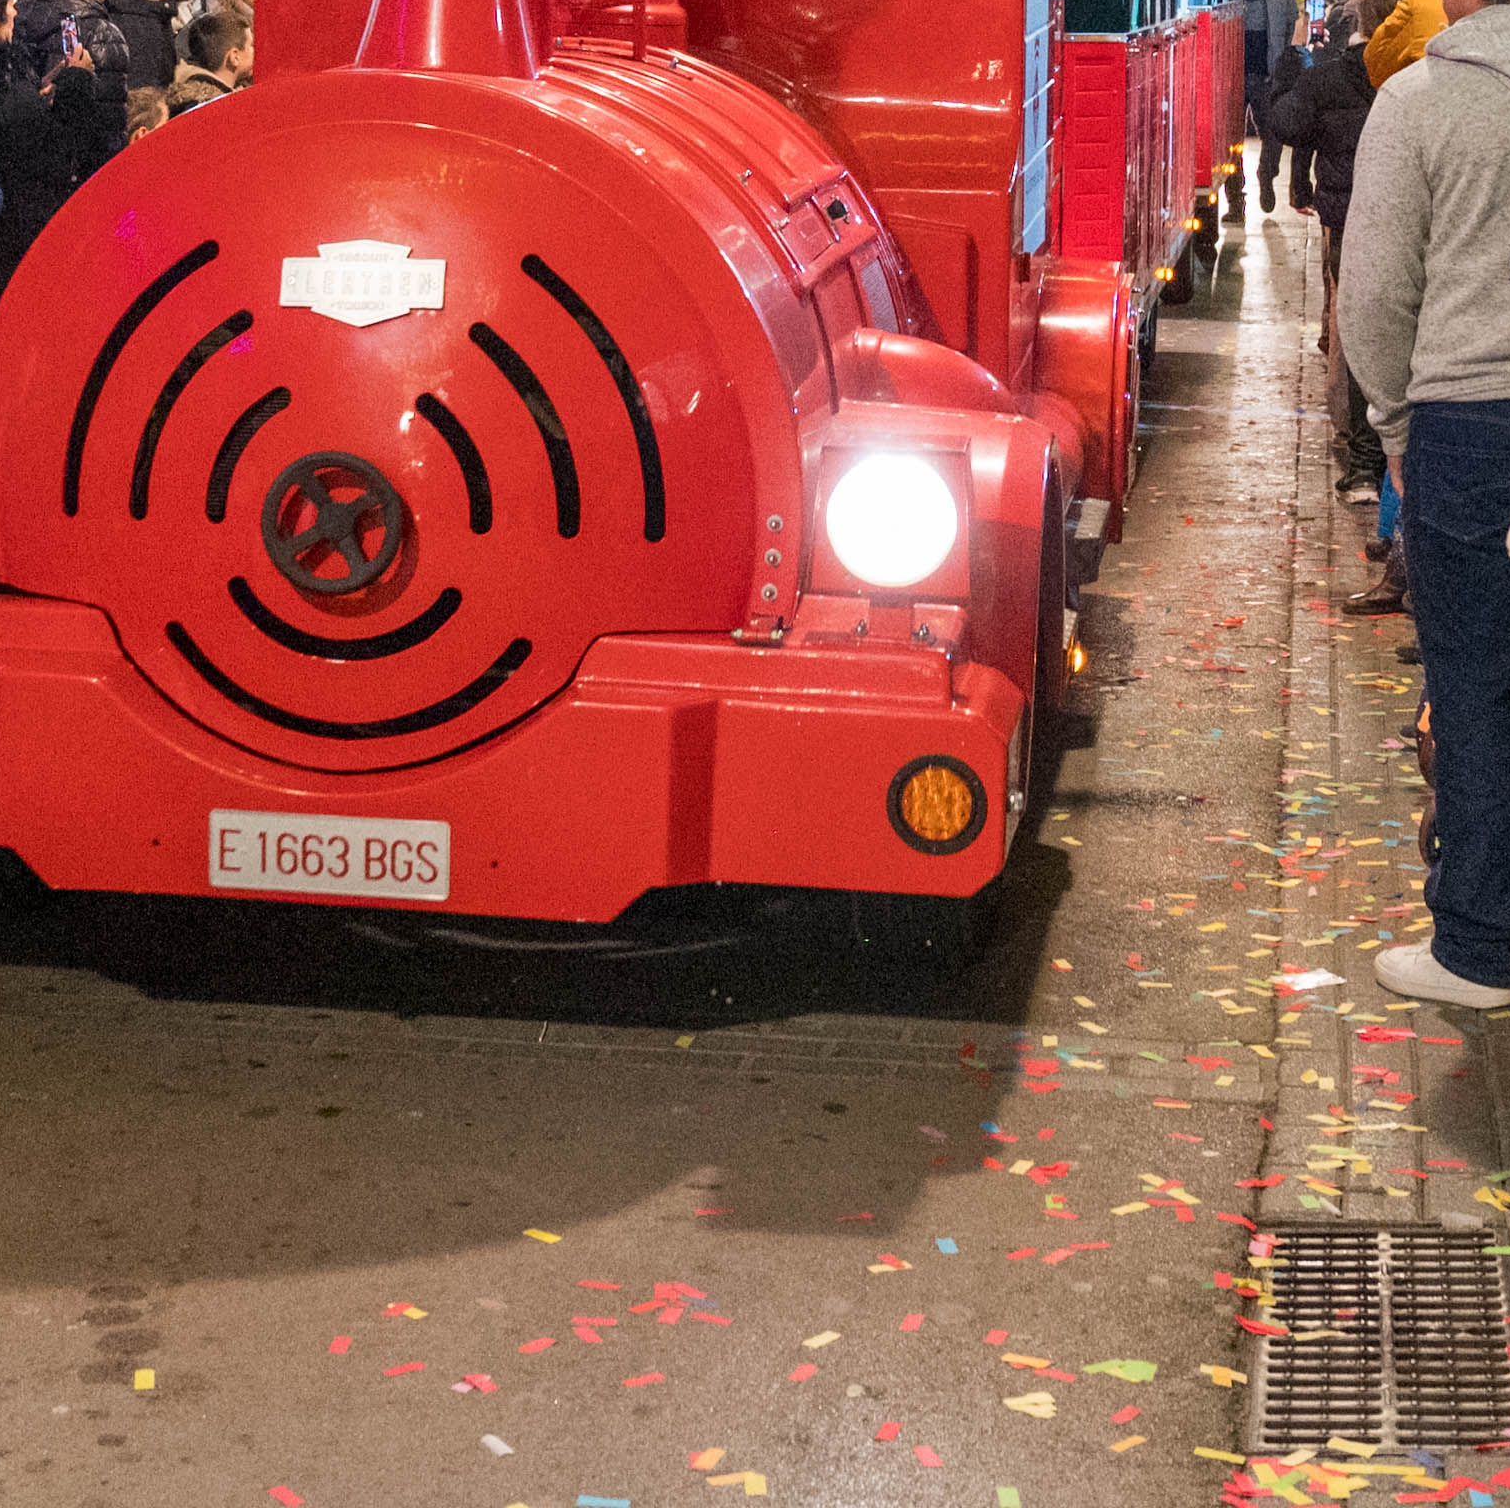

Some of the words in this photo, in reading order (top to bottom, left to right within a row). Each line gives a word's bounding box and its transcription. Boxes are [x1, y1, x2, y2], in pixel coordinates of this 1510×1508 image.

[219, 828, 241, 872] E
[258, 831, 350, 879] 1663
[364, 837, 439, 884] BGS
